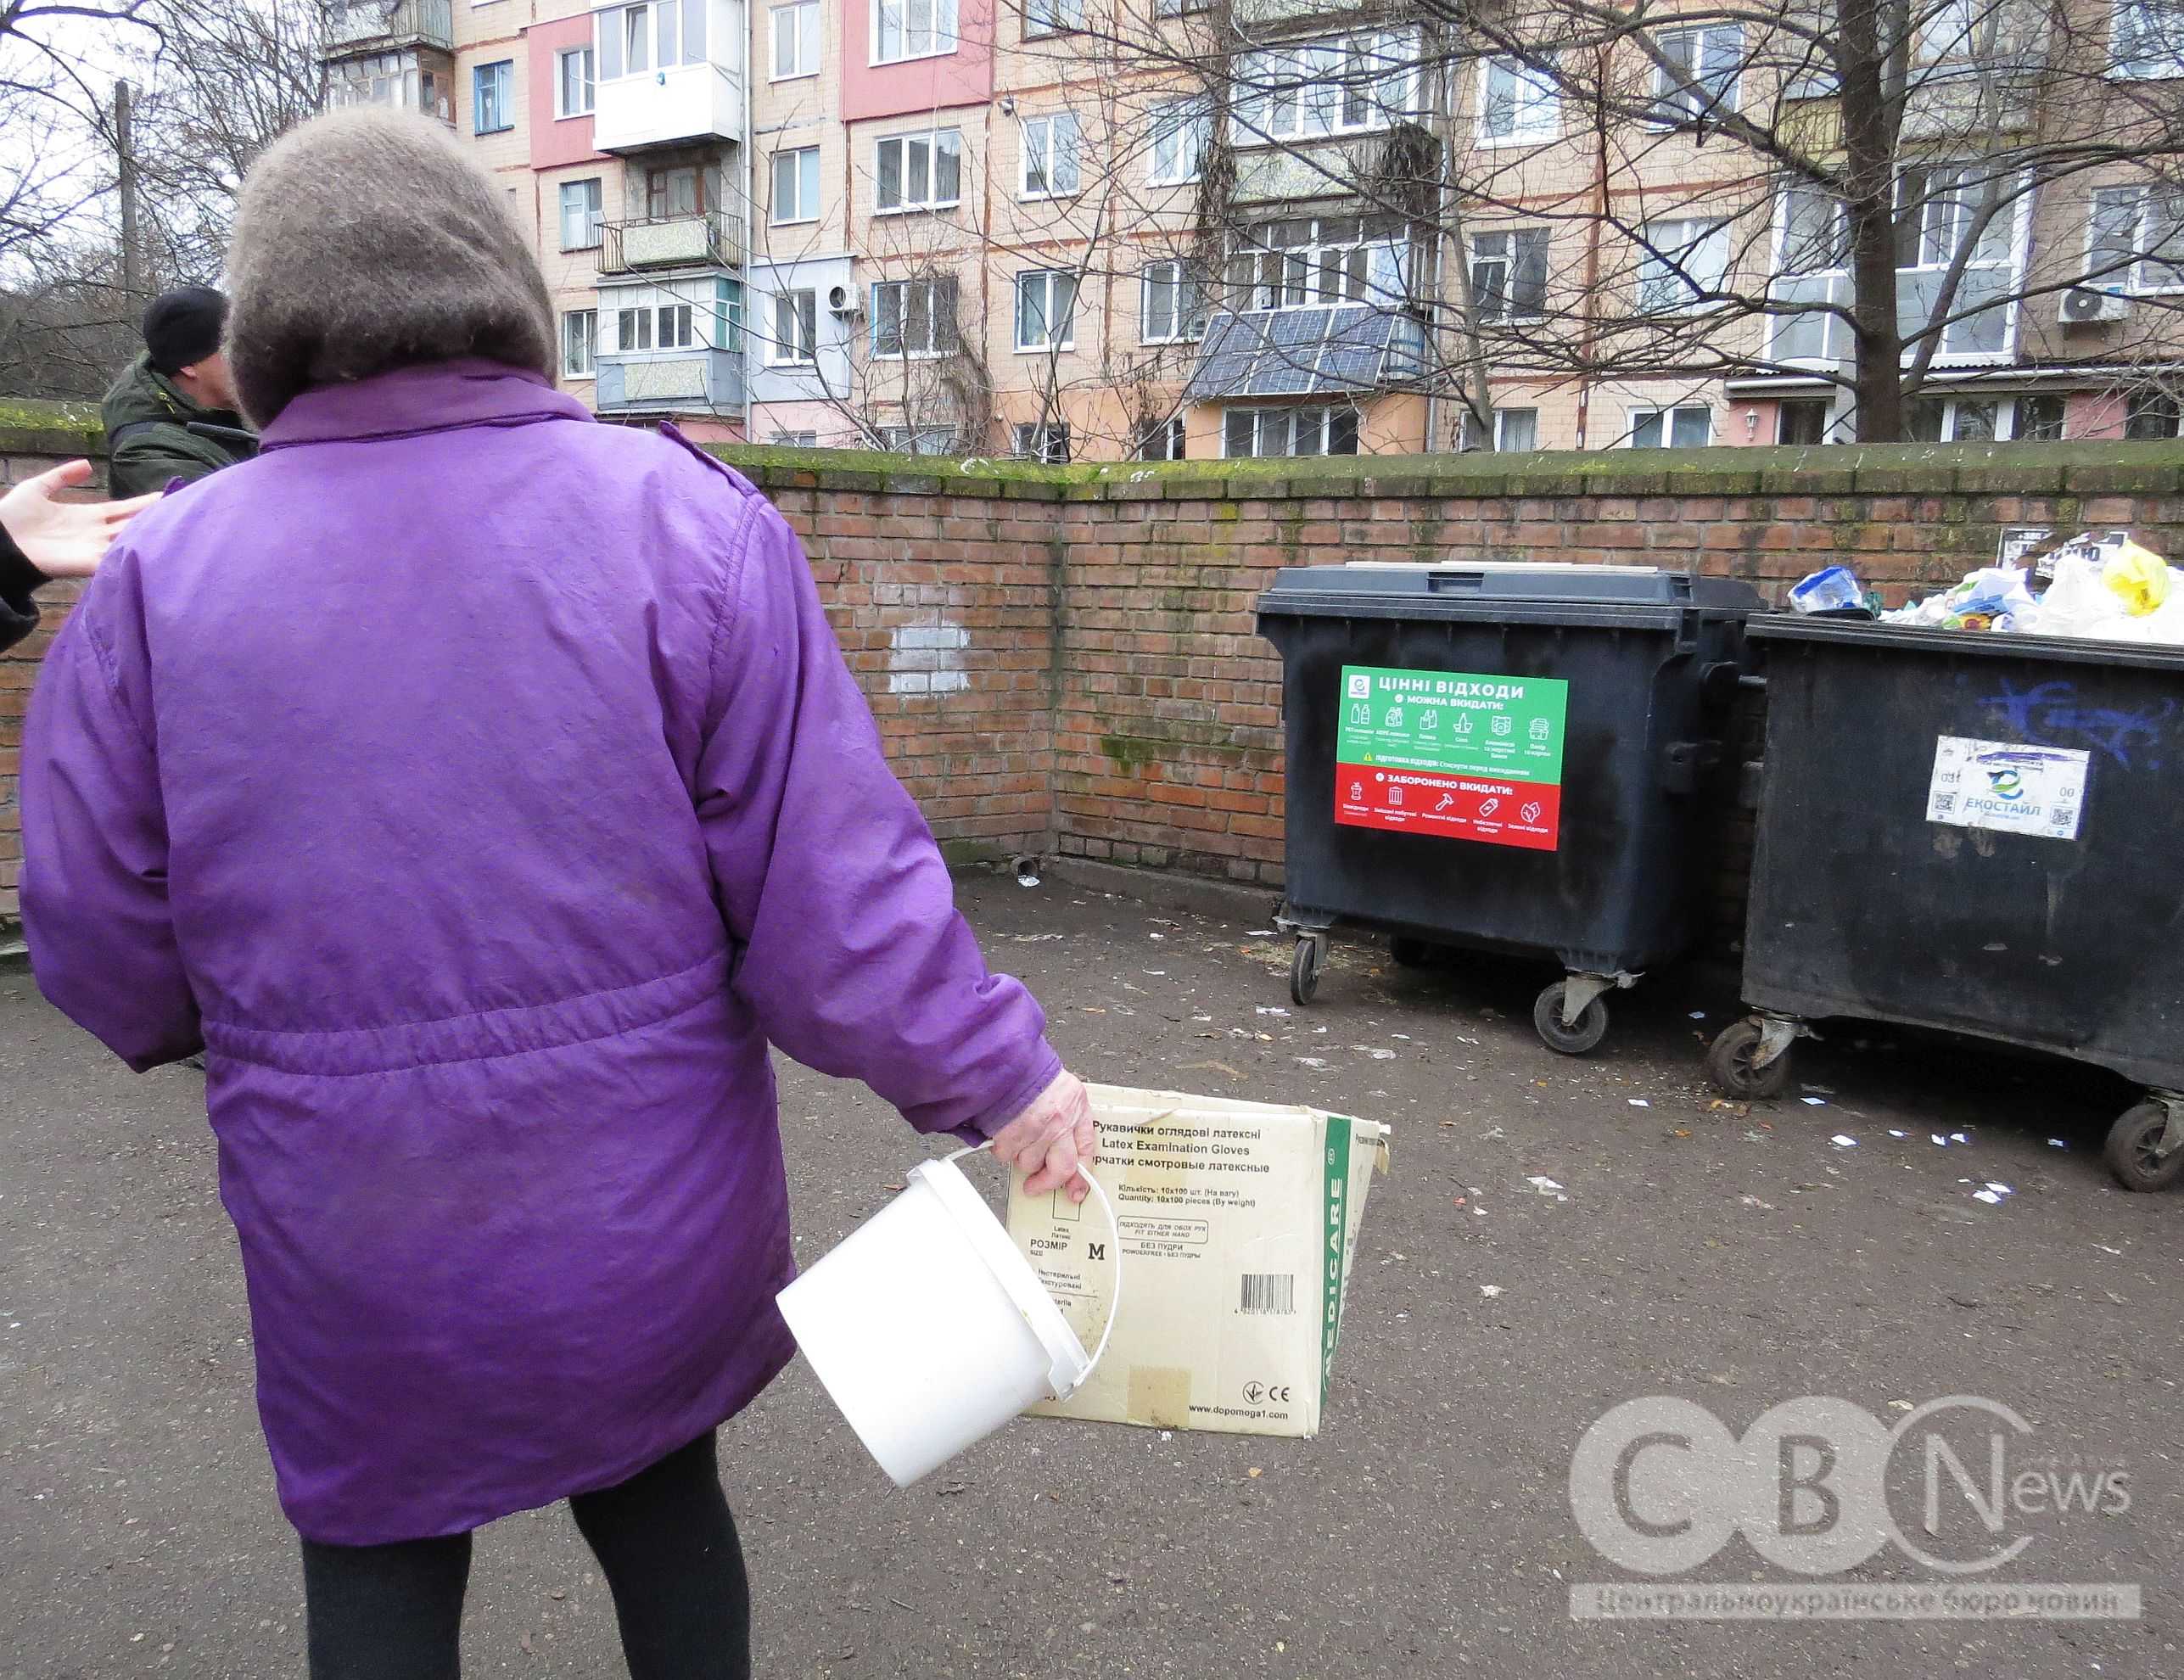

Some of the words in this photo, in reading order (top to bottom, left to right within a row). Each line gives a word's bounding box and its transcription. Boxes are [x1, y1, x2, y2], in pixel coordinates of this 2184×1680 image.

[1379, 677, 1431, 692] ЦІННІ
[1436, 680, 1524, 699] ВІДХОДИ
[1407, 696, 1448, 706] МОЖНА
[1450, 698, 1504, 710] ВКИДАТИ:
[1387, 774, 1457, 789] ЗАБОРОНЕНО
[1459, 781, 1513, 795] ВКИДАТИ:
[1966, 798, 2042, 816] ЕКОСТАЙЛ
[1093, 1120, 1154, 1135] Рукавички
[1157, 1124, 1210, 1138] оглядові
[1213, 1128, 1261, 1140] латексні
[1102, 1138, 1134, 1150] Latex
[1137, 1140, 1208, 1154] Examination
[1212, 1144, 1250, 1155] Gloves
[1138, 1158, 1205, 1171] смотровые
[1208, 1162, 1269, 1173] латексные
[1118, 1193, 1154, 1203] Quantity:
[1156, 1196, 1184, 1204] 10x100
[1185, 1197, 1210, 1206] pieces
[1212, 1198, 1225, 1207] (By
[1228, 1198, 1256, 1207] weight)
[1030, 1239, 1067, 1250] РОЗМІР
[1157, 1242, 1183, 1251] ПУДРИ
[1040, 1278, 1082, 1290] екстуровані
[1268, 1386, 1290, 1402] CE
[1189, 1404, 1289, 1420] www.dopomoga1.com
